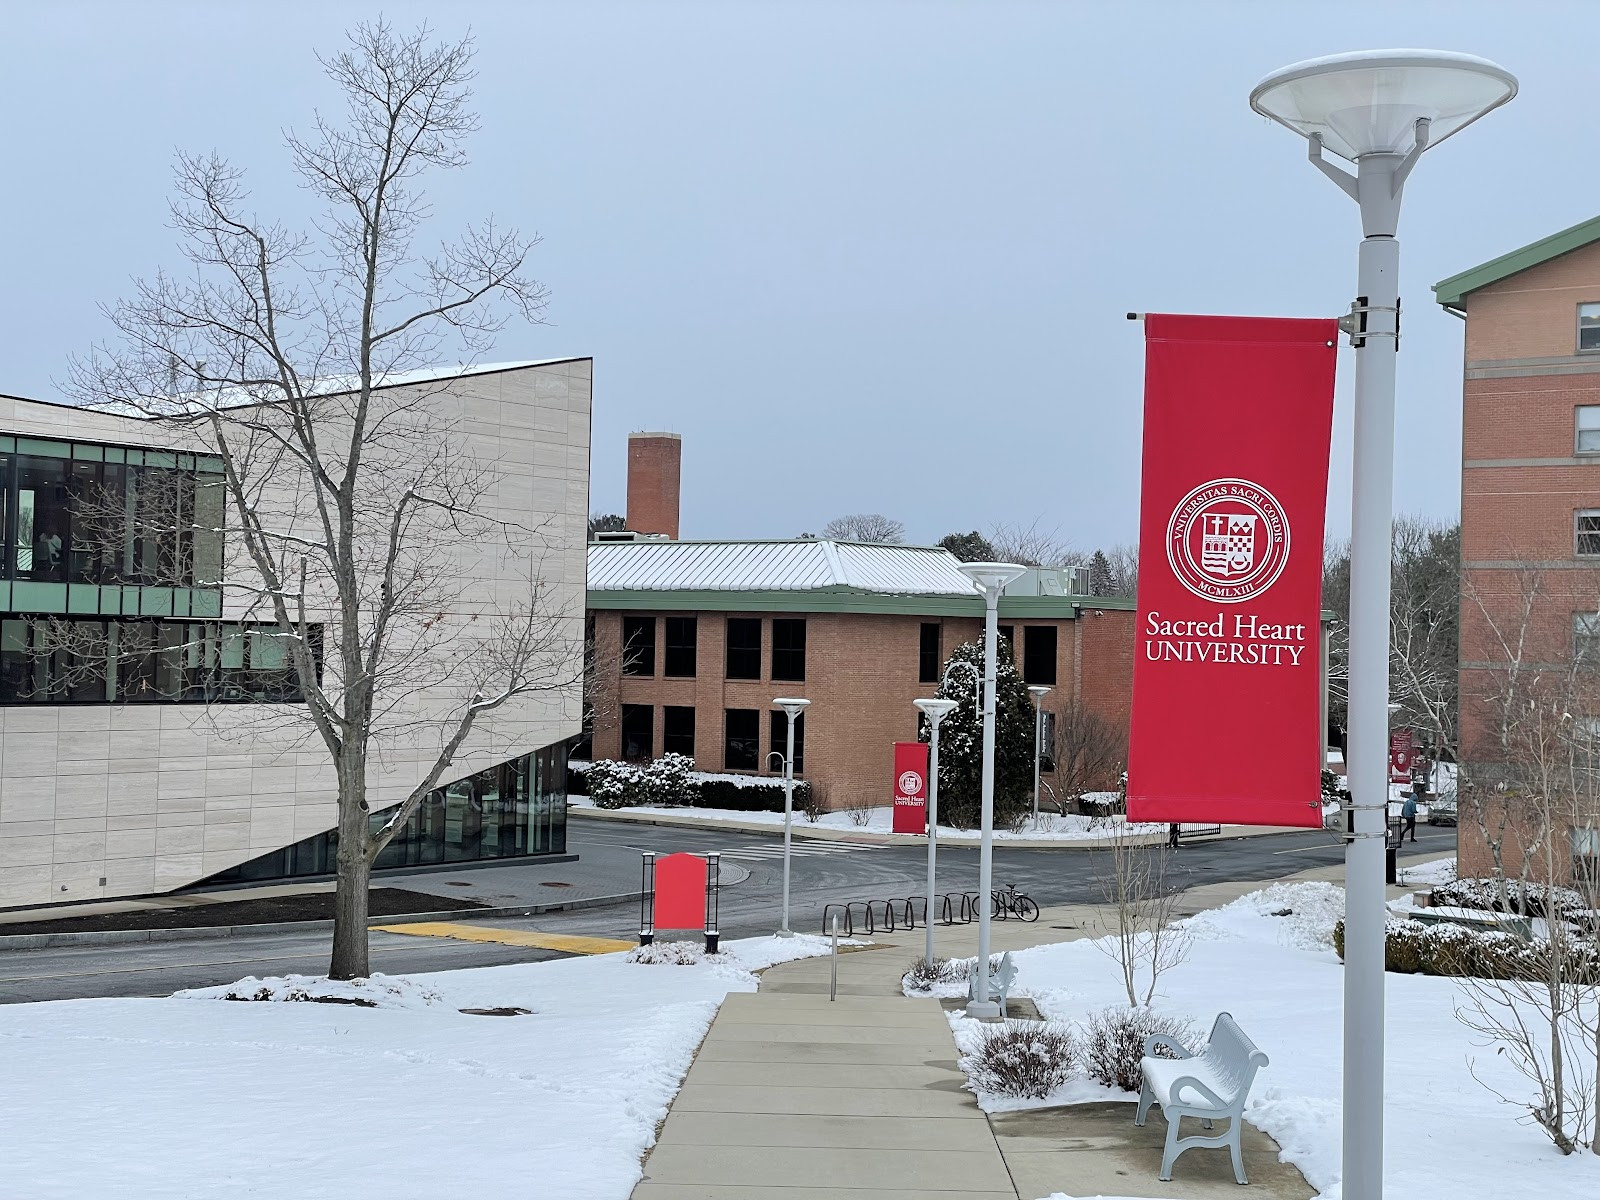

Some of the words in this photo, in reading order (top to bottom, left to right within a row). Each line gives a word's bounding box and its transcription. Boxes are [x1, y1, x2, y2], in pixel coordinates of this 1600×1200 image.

[1174, 487, 1228, 540] VNIVERSITAS
[1230, 486, 1263, 505] SACRI
[1264, 503, 1282, 543] CORDIS
[1198, 581, 1255, 597] MCMLXIII
[1146, 611, 1224, 637] Sacred
[1233, 614, 1305, 640] Heart
[1145, 640, 1305, 666] UNIVERSITY
